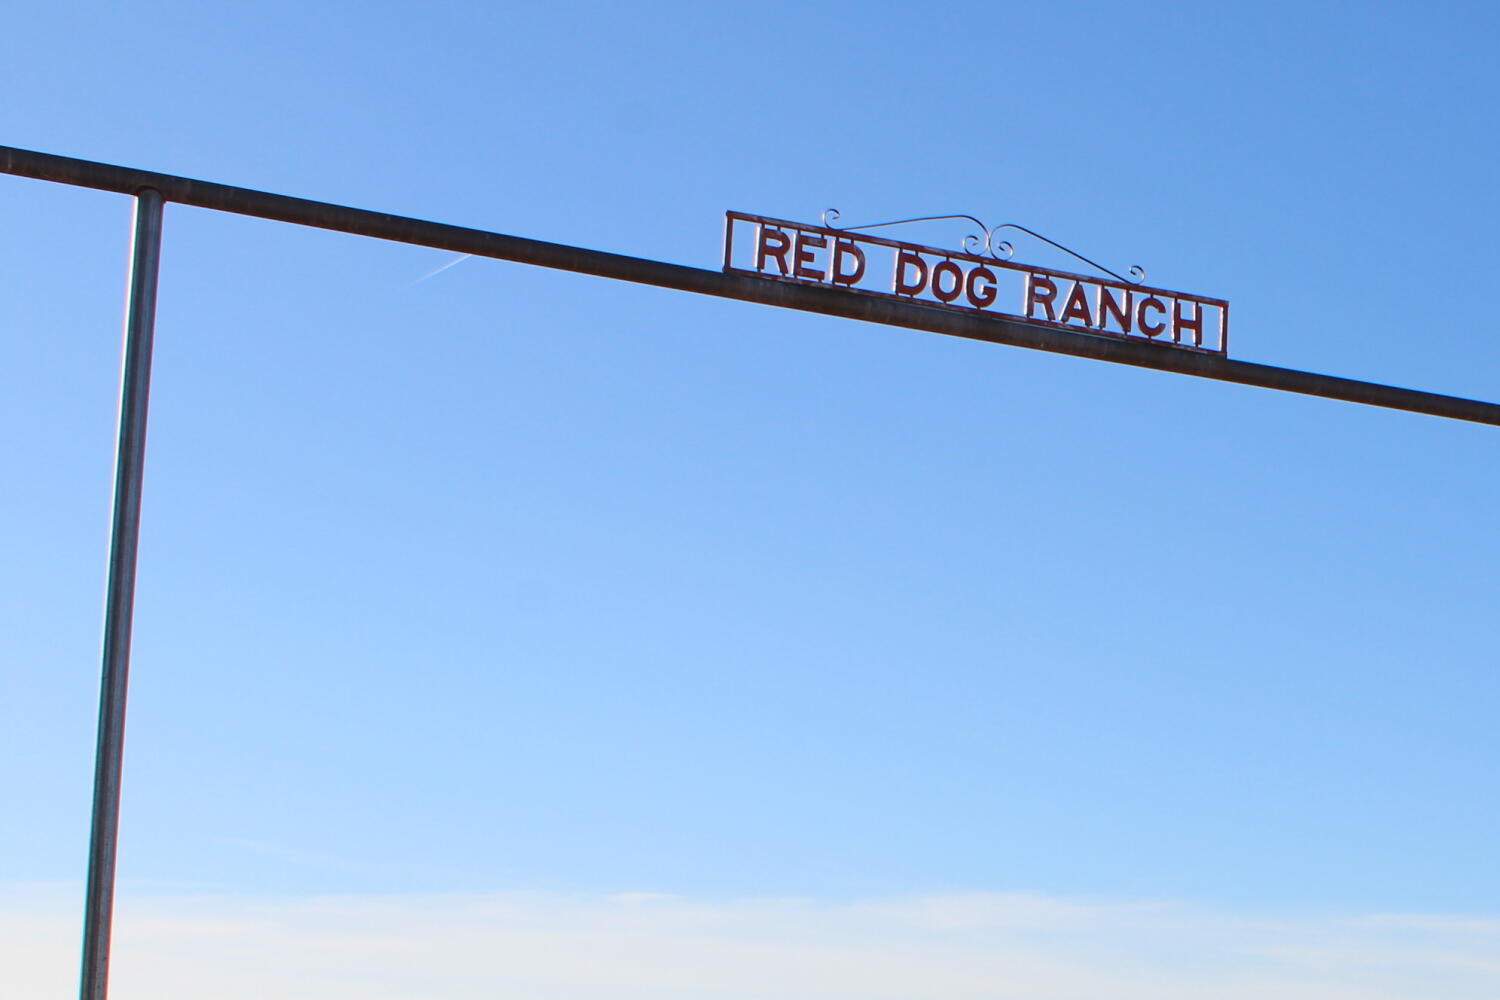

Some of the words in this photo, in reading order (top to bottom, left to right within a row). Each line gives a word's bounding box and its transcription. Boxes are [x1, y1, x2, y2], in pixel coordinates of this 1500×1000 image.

[758, 226, 866, 286] RED
[897, 249, 998, 308] DOG
[1026, 272, 1203, 346] RANCH
